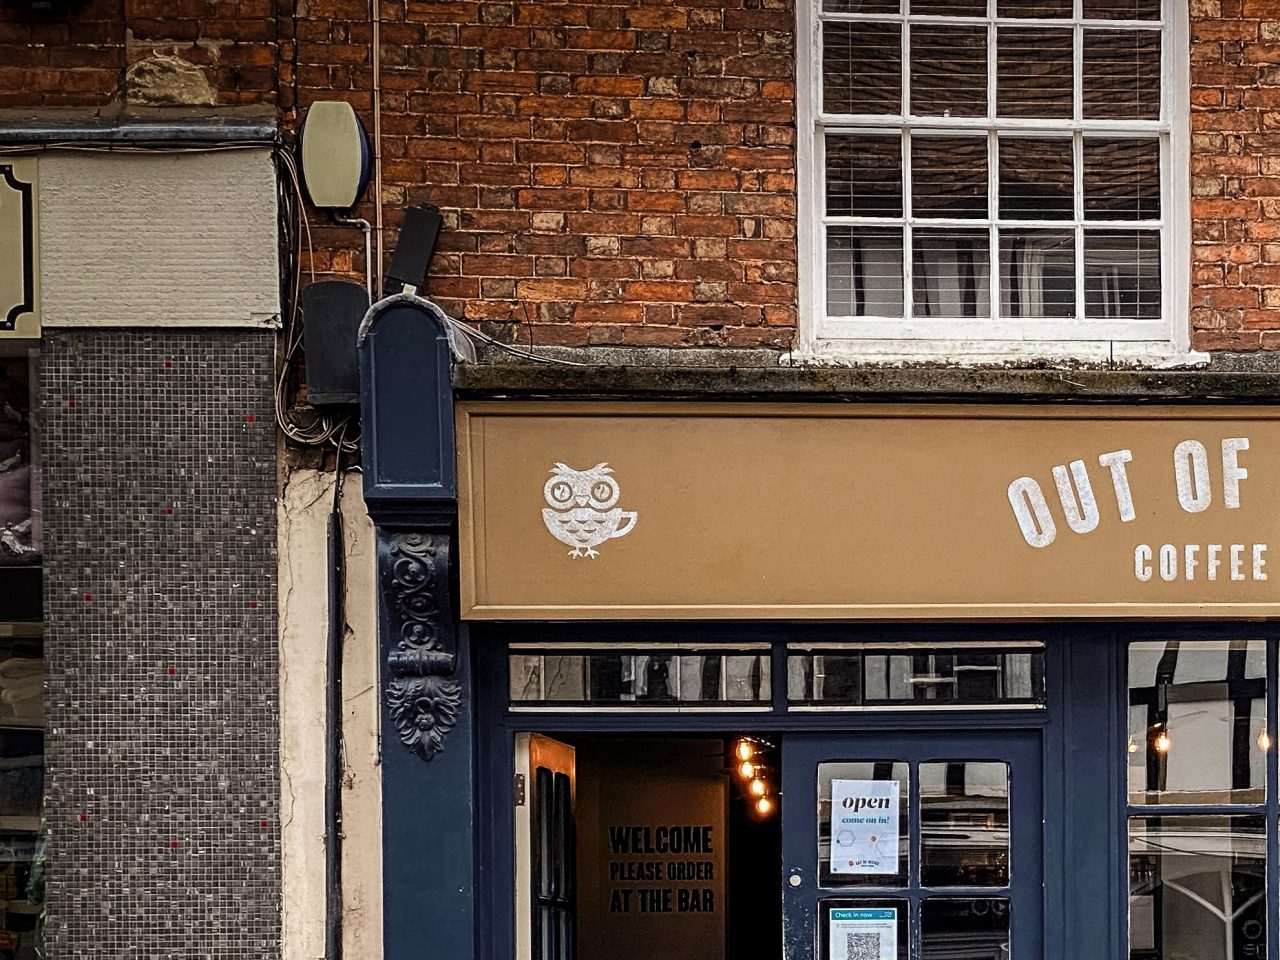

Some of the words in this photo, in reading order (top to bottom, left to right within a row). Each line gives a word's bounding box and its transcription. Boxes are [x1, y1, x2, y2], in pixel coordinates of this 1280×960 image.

[1007, 449, 1136, 548] OUT
[1173, 437, 1250, 513] OF
[1134, 544, 1268, 582] COFFEE
[842, 797, 890, 812] open
[878, 816, 890, 824] in!
[609, 826, 714, 854] WELCOME
[609, 862, 663, 881] PLEASE
[667, 862, 714, 881] ORDER
[610, 889, 634, 913] AT
[638, 889, 673, 913] THE
[677, 889, 715, 913] BAR
